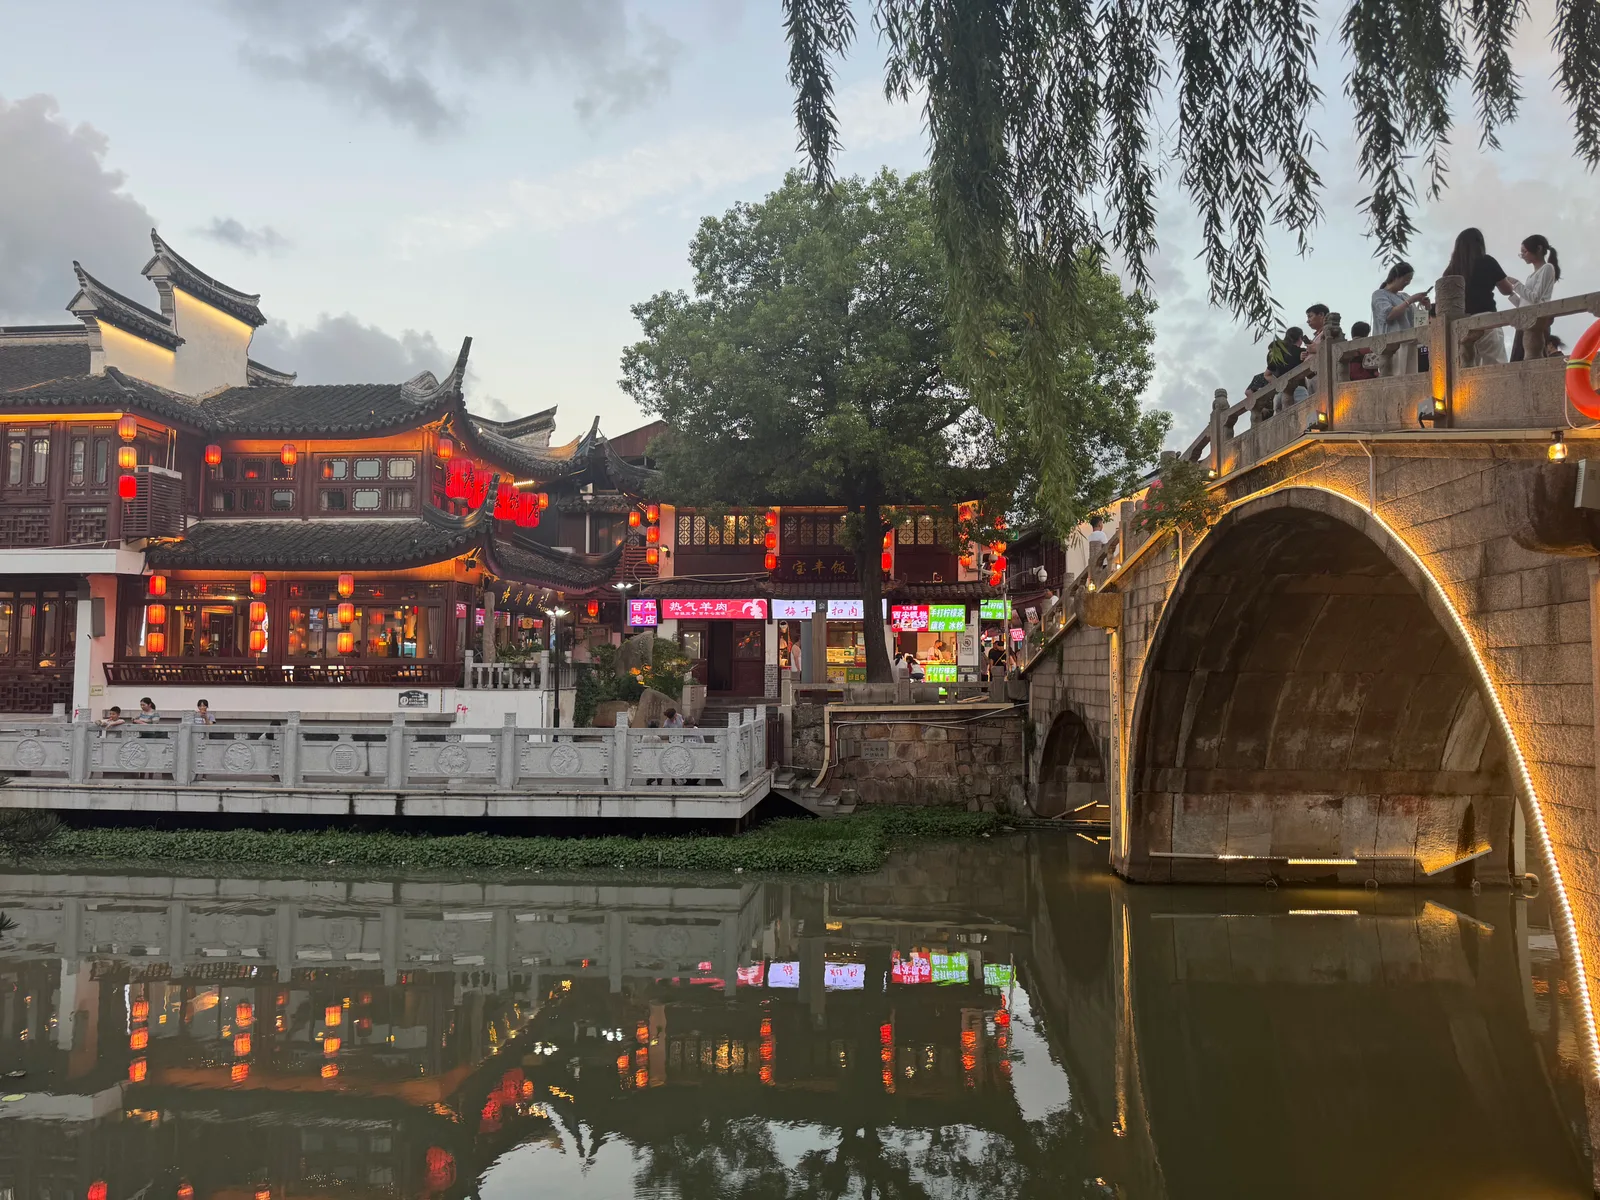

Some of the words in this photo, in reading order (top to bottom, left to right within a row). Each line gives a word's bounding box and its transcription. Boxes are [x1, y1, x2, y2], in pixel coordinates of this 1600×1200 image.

[792, 558, 858, 576] 宝丰饭
[631, 601, 657, 611] 百年
[669, 601, 728, 612] 热气羊肉
[631, 614, 657, 624] 老店
